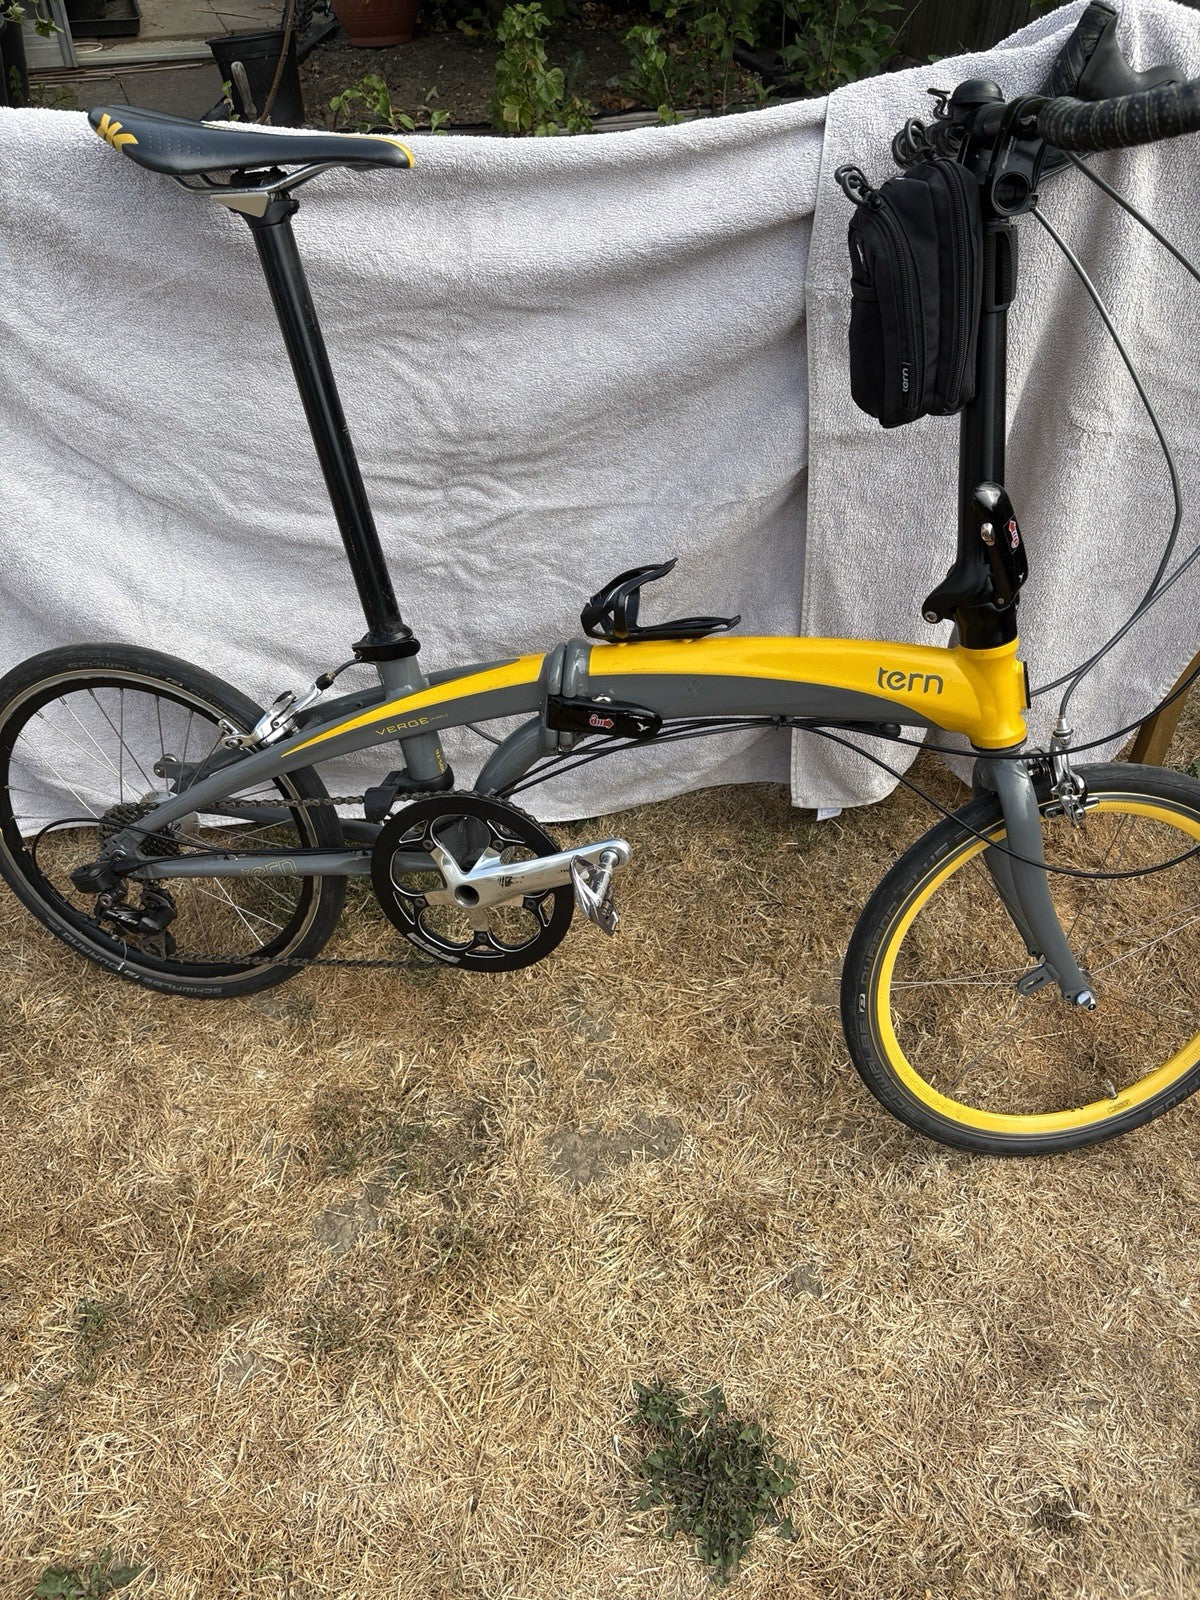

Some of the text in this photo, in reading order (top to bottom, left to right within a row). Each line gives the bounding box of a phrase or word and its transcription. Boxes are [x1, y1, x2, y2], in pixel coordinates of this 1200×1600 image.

[877, 666, 944, 695] tern
[375, 717, 430, 736] VERGE
[241, 858, 298, 878] tern
[142, 977, 223, 995] SCHWALBE
